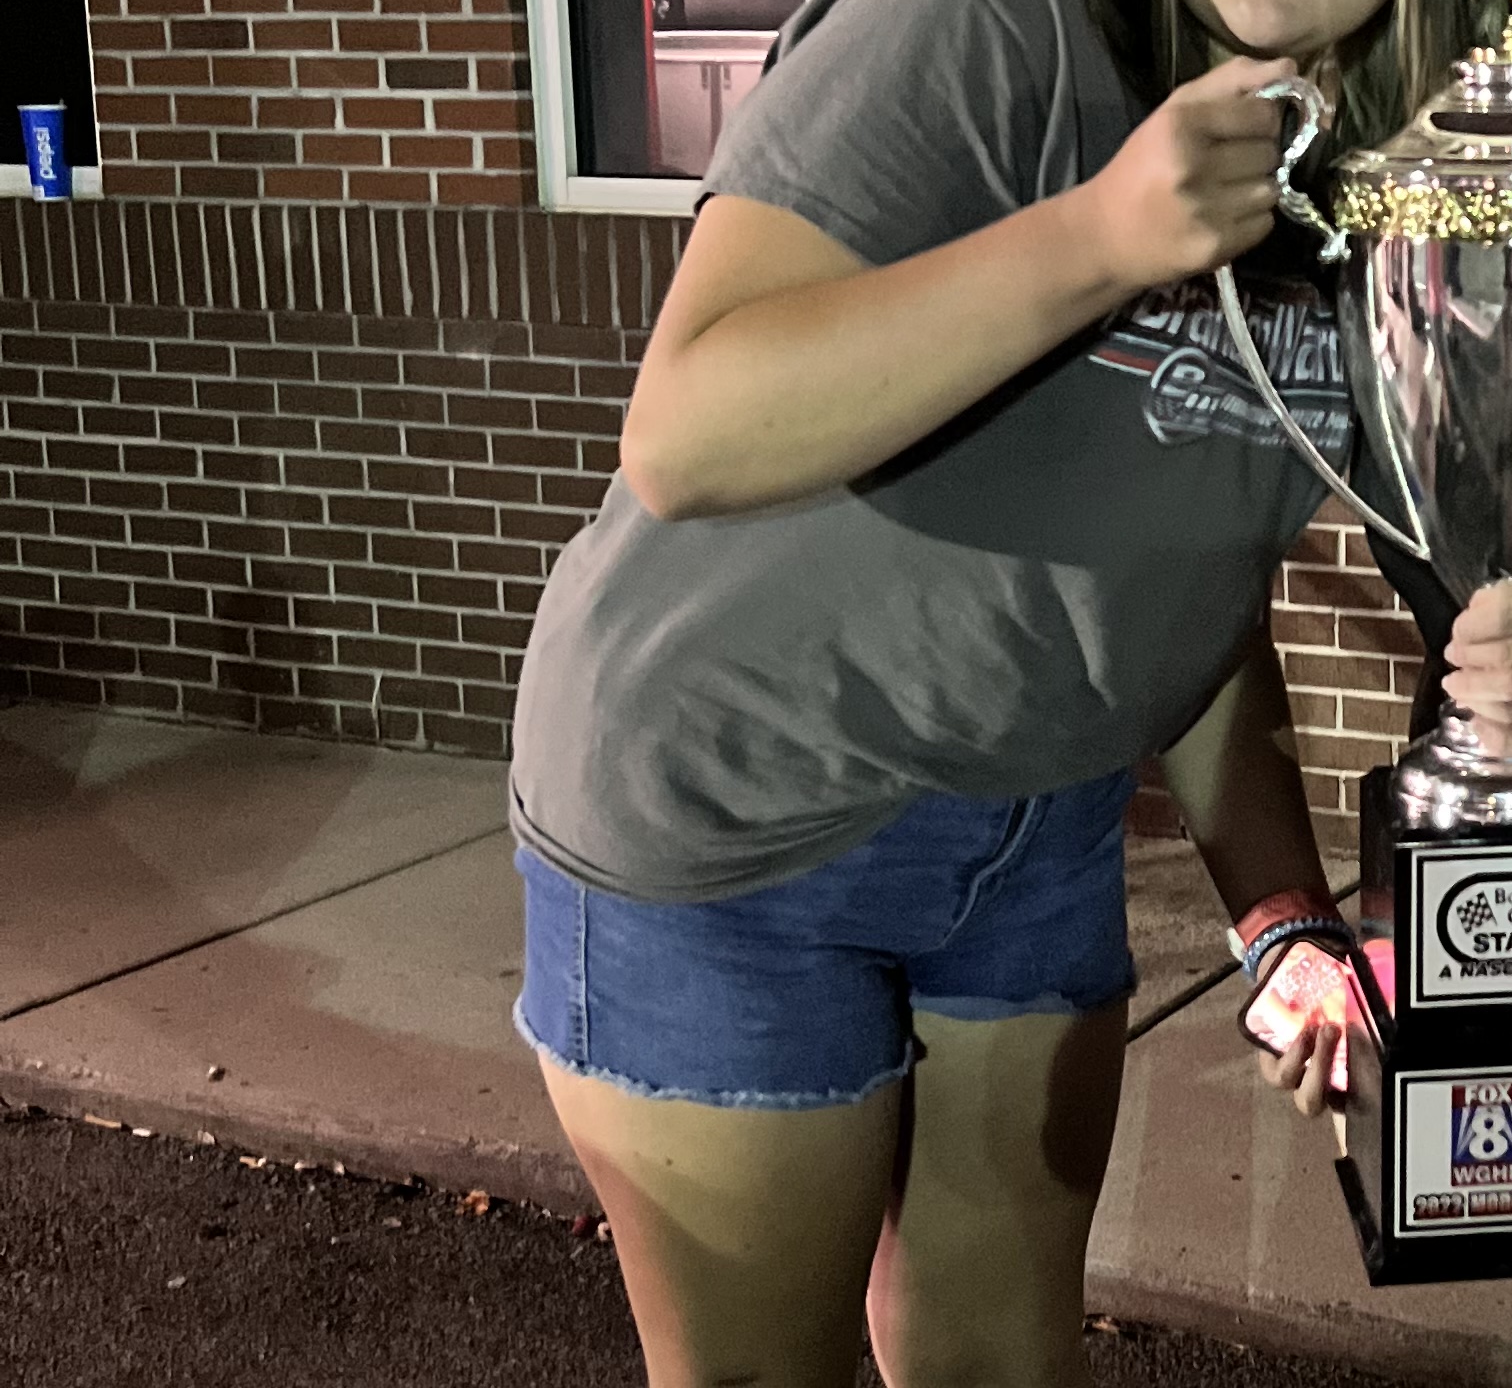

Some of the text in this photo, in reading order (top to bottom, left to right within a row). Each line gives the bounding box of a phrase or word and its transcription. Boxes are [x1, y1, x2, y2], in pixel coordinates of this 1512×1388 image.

[1438, 964, 1453, 979] A
[1464, 1083, 1512, 1107] FOX
[1469, 1105, 1508, 1161] 8
